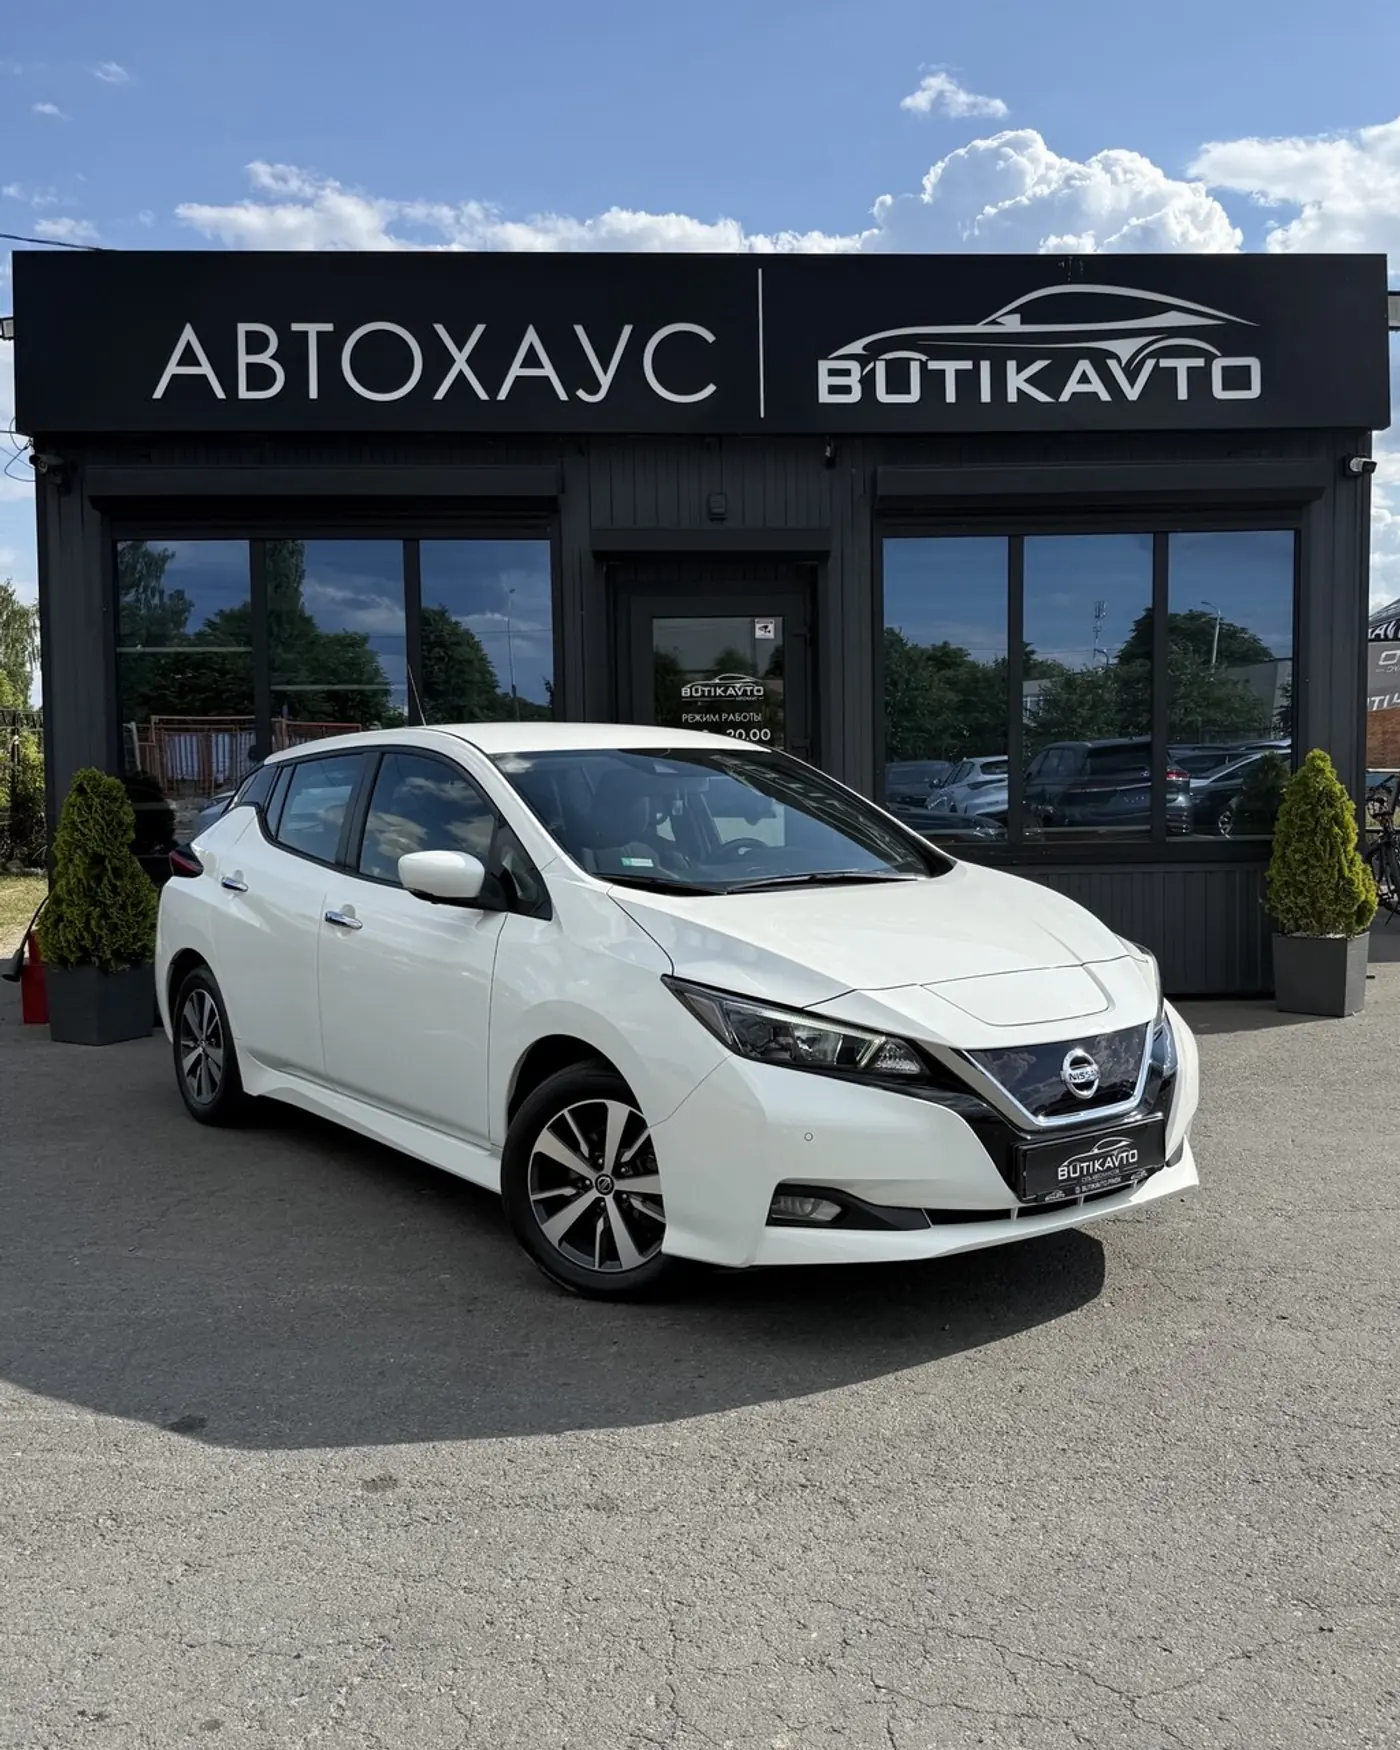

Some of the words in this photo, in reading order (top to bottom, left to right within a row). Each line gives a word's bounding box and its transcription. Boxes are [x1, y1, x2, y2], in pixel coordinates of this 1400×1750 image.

[152, 321, 717, 404] АВТОХАУС
[817, 355, 1261, 404] BUTIKAVTO
[681, 686, 764, 697] BUTIKAVTO
[682, 713, 720, 723] РЕЖИМ
[721, 712, 762, 722] РАБОТЫ
[1058, 1149, 1138, 1180] BUTIKAVTO
